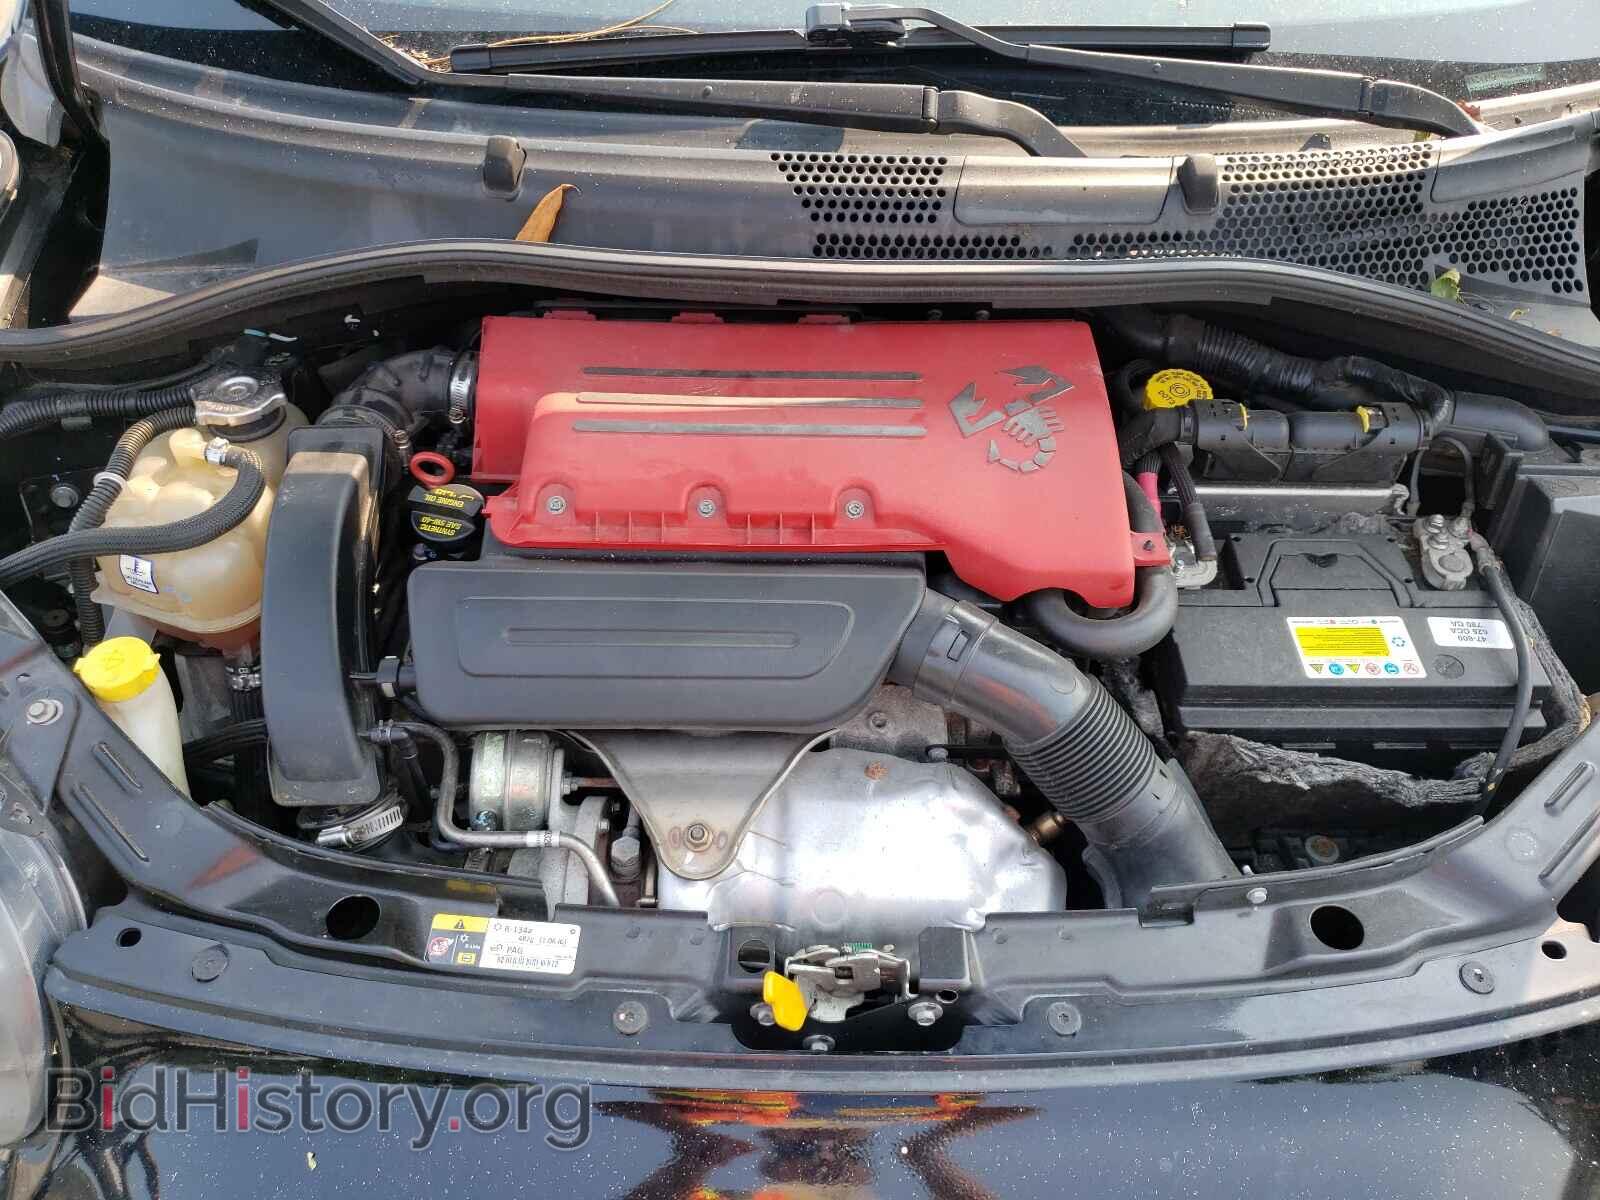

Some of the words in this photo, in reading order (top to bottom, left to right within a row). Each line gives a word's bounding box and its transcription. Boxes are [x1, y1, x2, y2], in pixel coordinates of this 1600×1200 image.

[423, 494, 437, 503] OIL
[437, 497, 464, 507] ENGINE
[419, 523, 456, 536] SYNTHETIC
[446, 521, 462, 530] SAE
